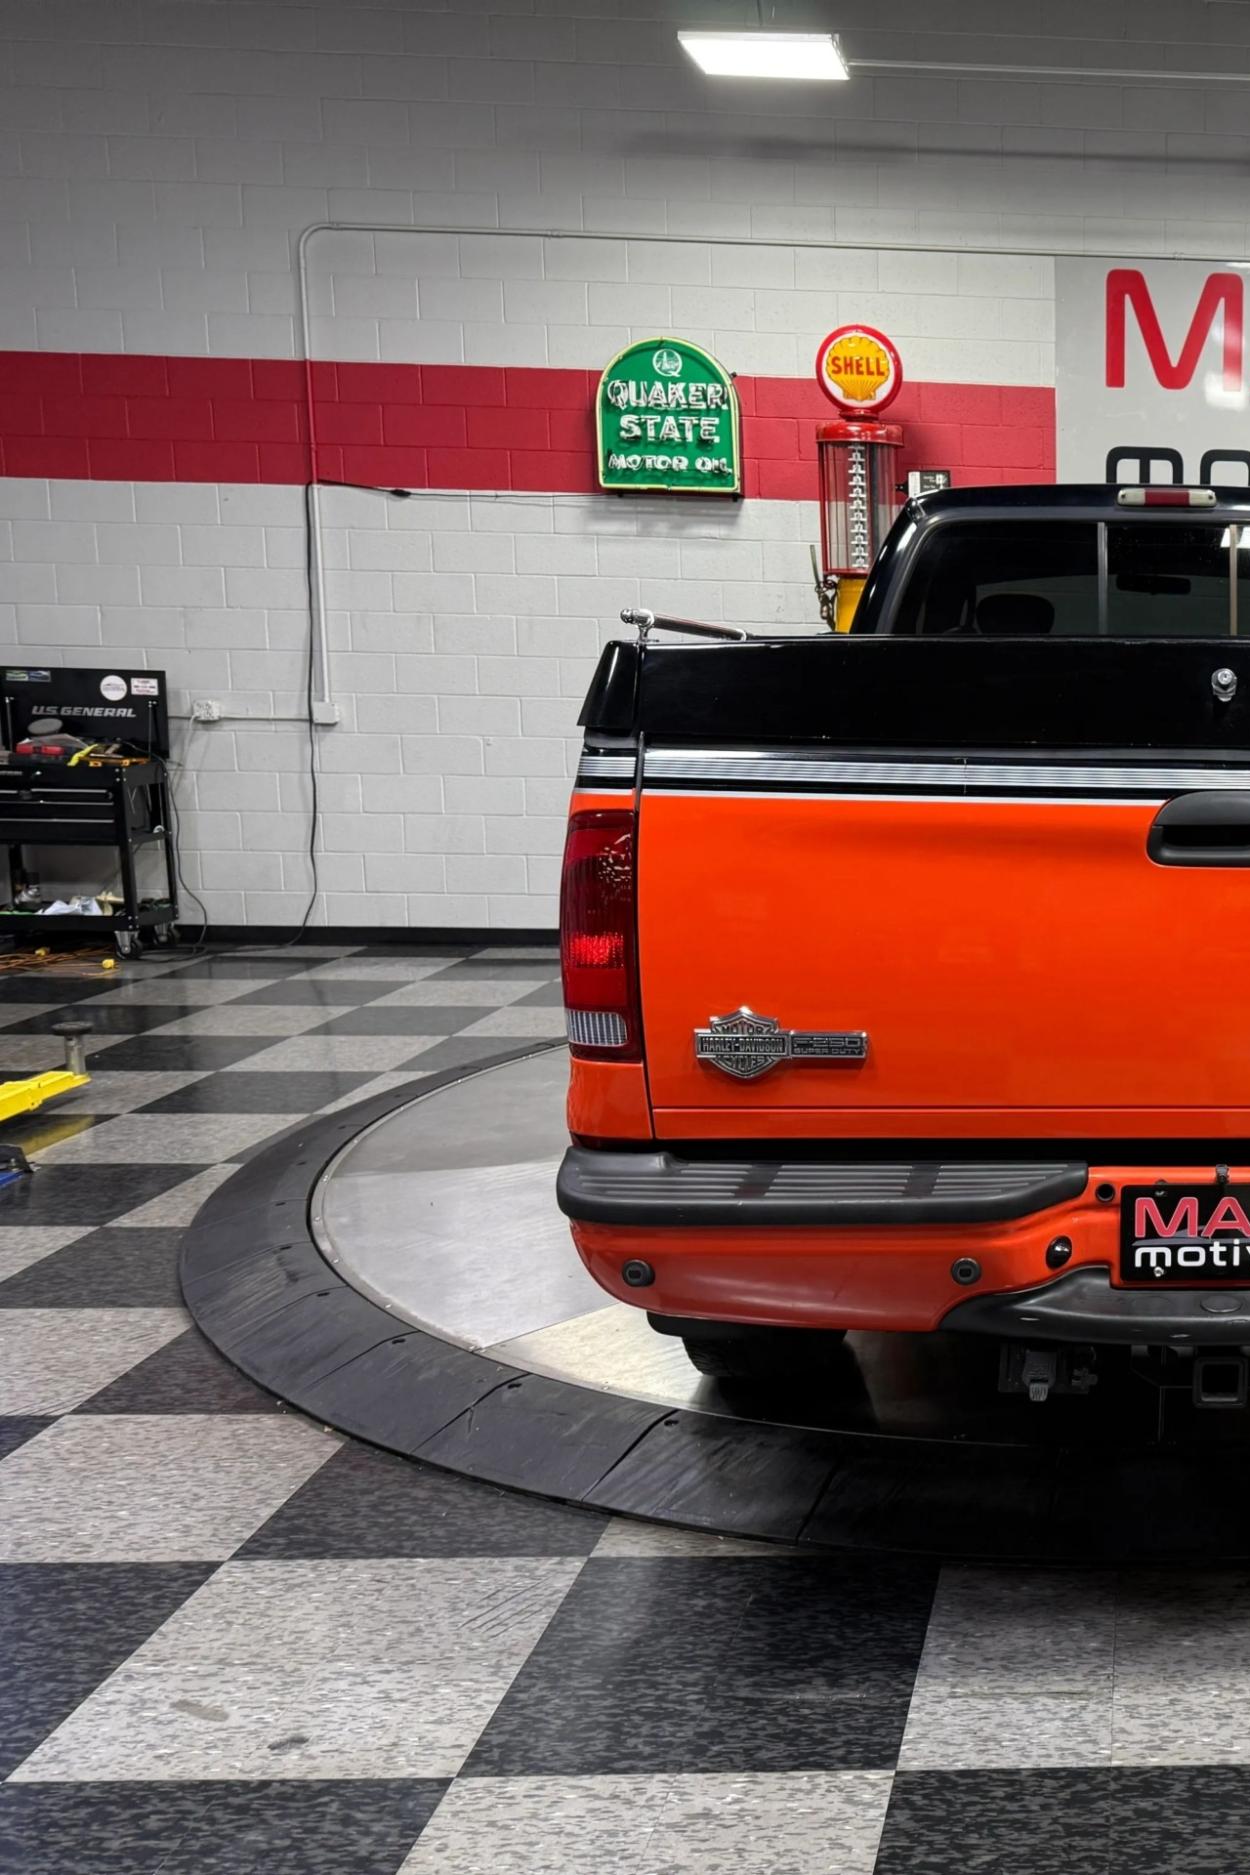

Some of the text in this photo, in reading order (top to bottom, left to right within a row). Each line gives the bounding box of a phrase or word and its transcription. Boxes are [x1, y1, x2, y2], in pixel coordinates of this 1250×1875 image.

[831, 357, 886, 377] SHELL
[607, 379, 729, 411] QUAKER
[619, 414, 720, 443] STATE
[608, 453, 733, 474] MOTOR OIL
[60, 706, 137, 718] GENERAL
[720, 1019, 765, 1035] MOTOR
[702, 1037, 784, 1053] HARLEY-DAVIDSON
[793, 1037, 861, 1048] F-250
[831, 1048, 861, 1056] DUTY
[722, 1055, 766, 1071] CYCLES
